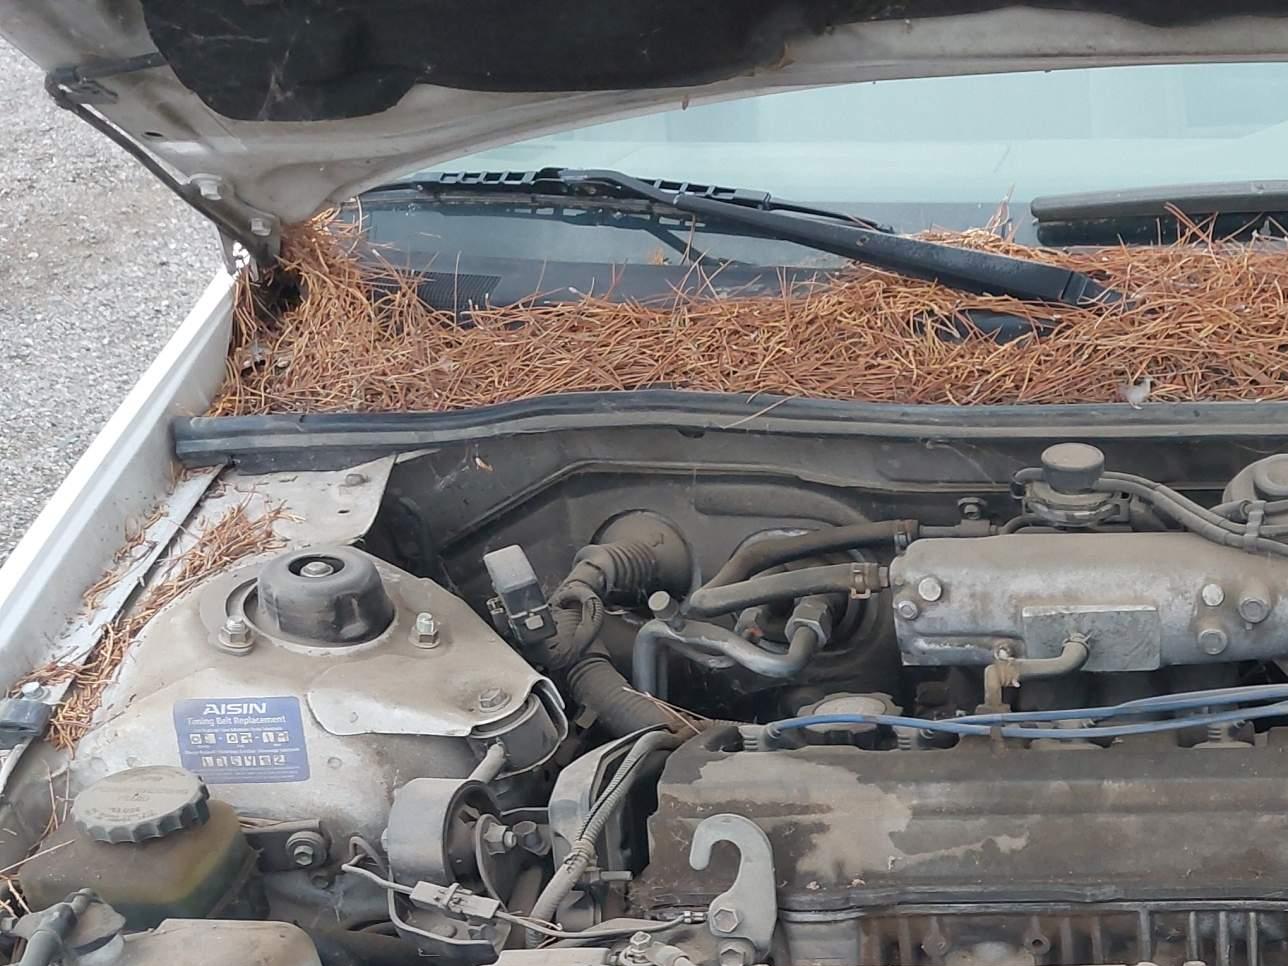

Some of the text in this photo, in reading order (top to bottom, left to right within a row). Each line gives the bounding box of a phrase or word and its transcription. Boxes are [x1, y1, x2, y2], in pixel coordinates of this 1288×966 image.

[203, 703, 267, 715] AISIN
[187, 715, 286, 726] Timing Belt Replacement
